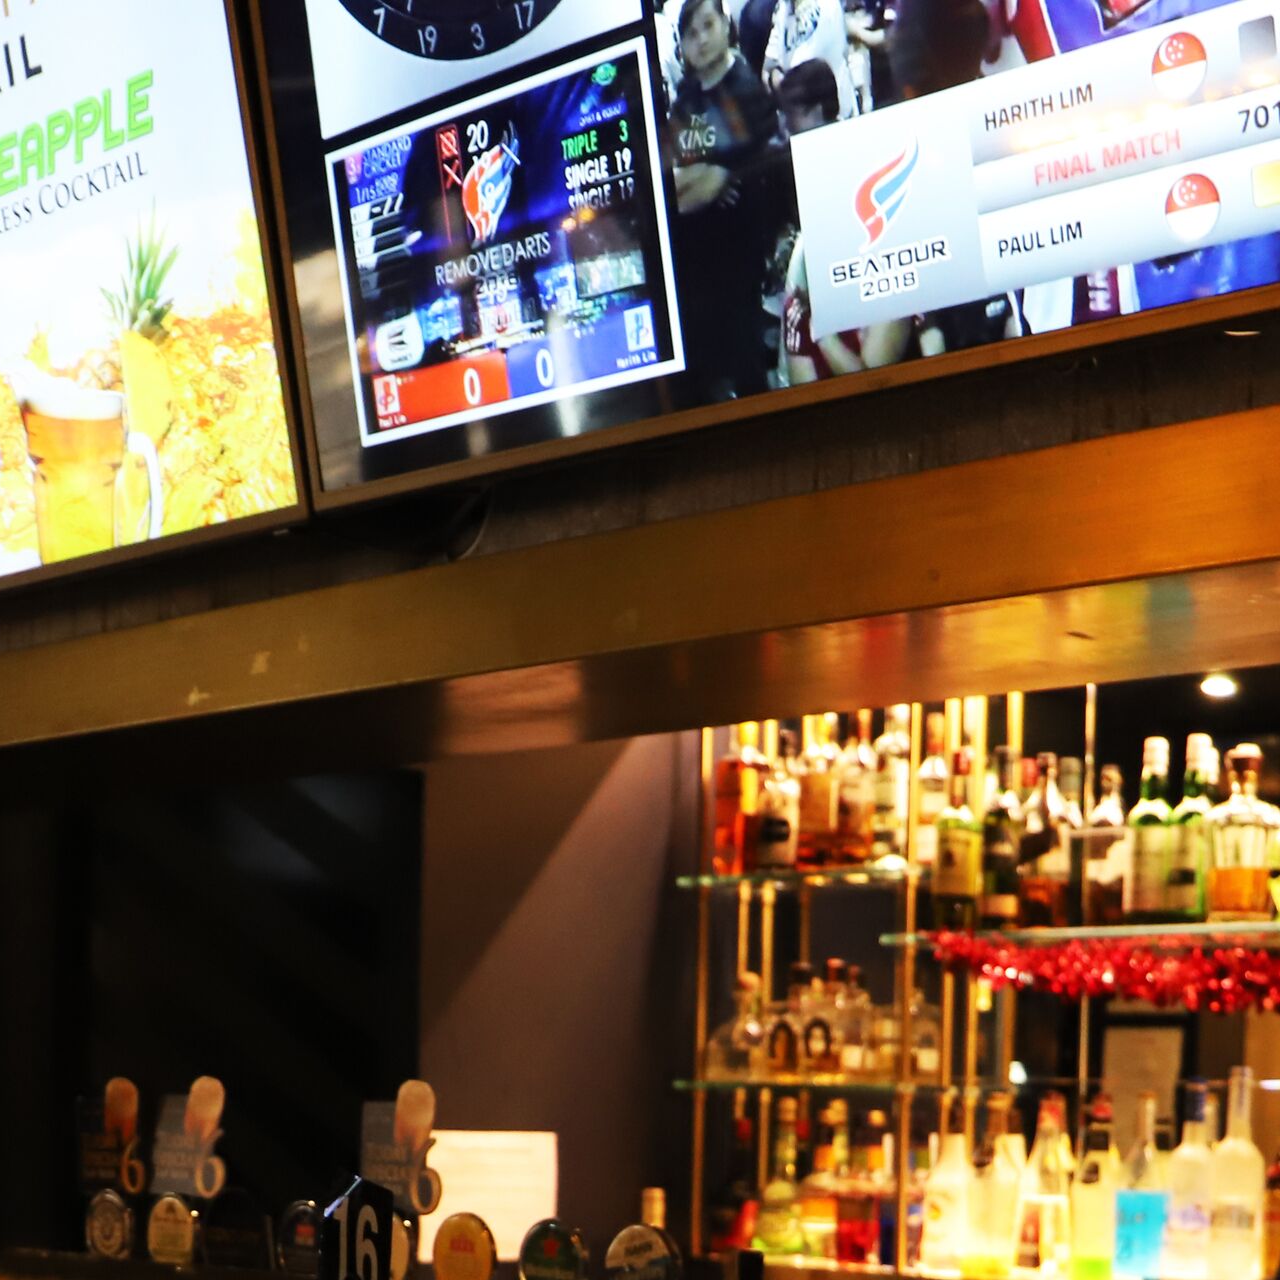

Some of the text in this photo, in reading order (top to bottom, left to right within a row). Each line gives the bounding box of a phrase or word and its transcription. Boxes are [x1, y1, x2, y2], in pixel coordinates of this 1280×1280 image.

[372, 6, 386, 37] 7
[417, 24, 437, 54] 19
[470, 23, 487, 52] 3
[983, 83, 1093, 132] HARITH LIM
[466, 120, 489, 153] 20
[561, 120, 629, 160] TRIPLE 3
[565, 147, 632, 190] SINGLE 19
[1034, 128, 1182, 187] FINAL MATCH
[39, 152, 148, 214] COCKTAIL
[568, 183, 611, 216] SINGLE
[998, 221, 1083, 258] PAUL LIM
[435, 232, 551, 286] REMOVE DARTS
[862, 270, 917, 297] 2018
[463, 368, 482, 405] 0
[535, 349, 554, 388] 0
